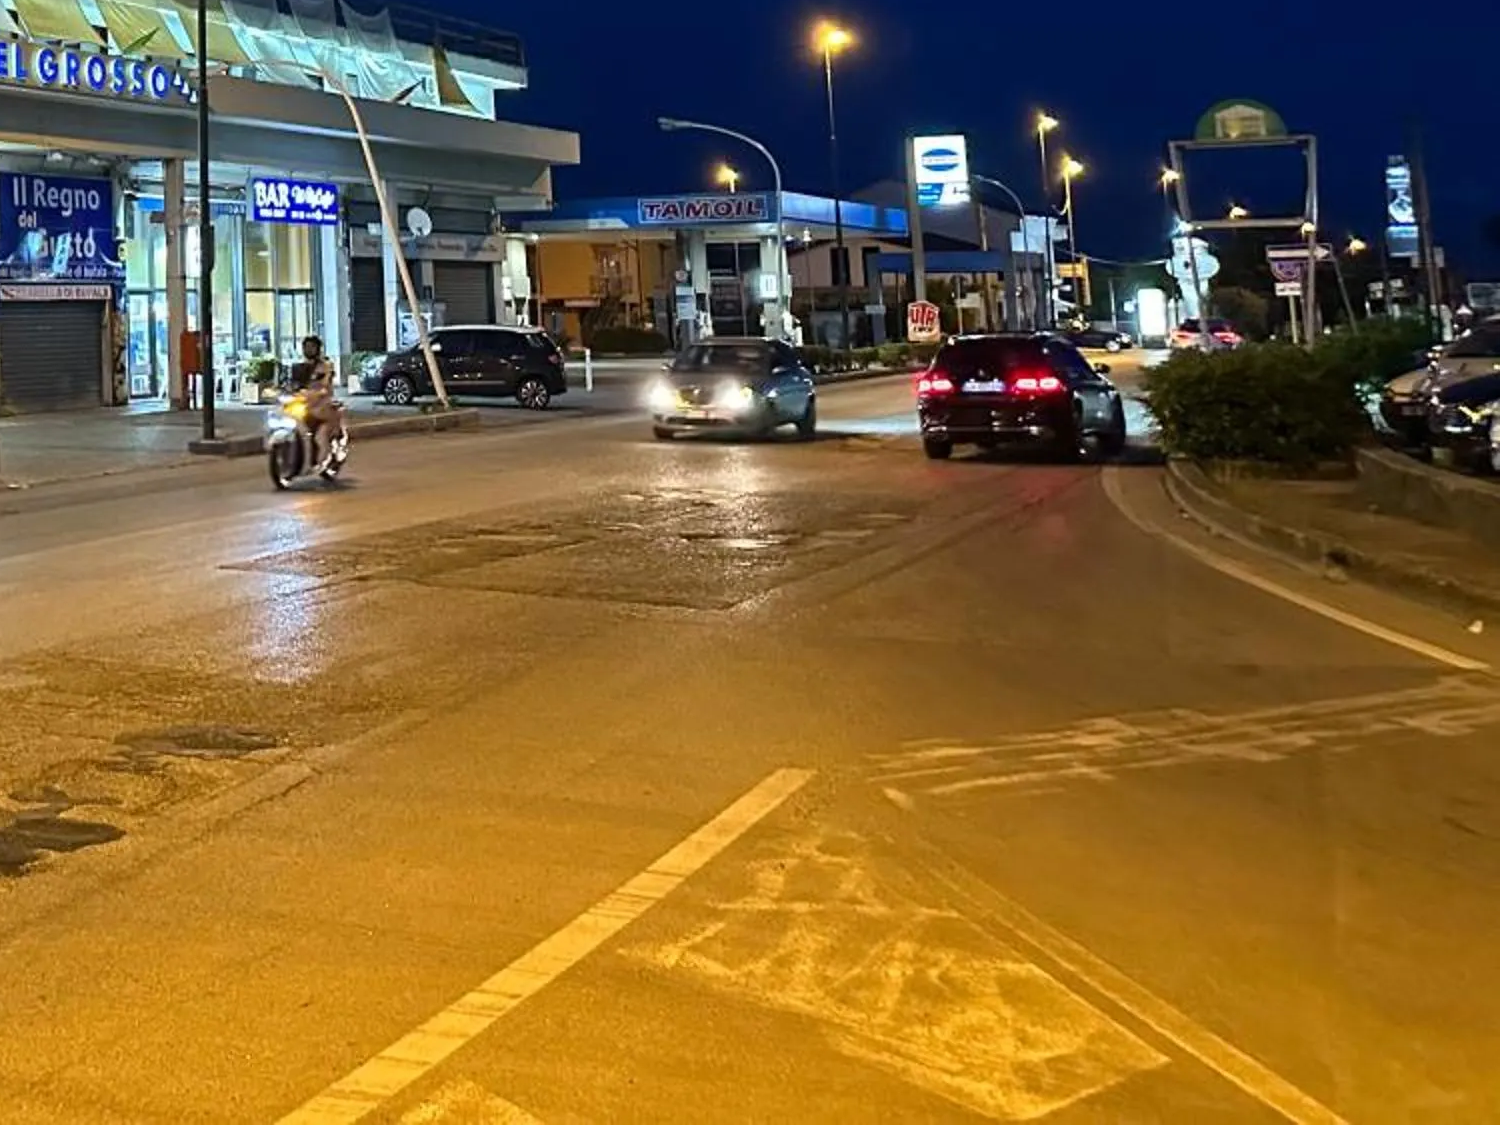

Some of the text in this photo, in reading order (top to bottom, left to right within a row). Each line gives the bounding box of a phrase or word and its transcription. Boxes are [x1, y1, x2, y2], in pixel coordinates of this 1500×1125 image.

[35, 46, 169, 100] GROSSO
[13, 176, 100, 216] Il Regno
[254, 180, 290, 208] BAR
[18, 210, 38, 229] del
[643, 200, 762, 219] TAMOIL
